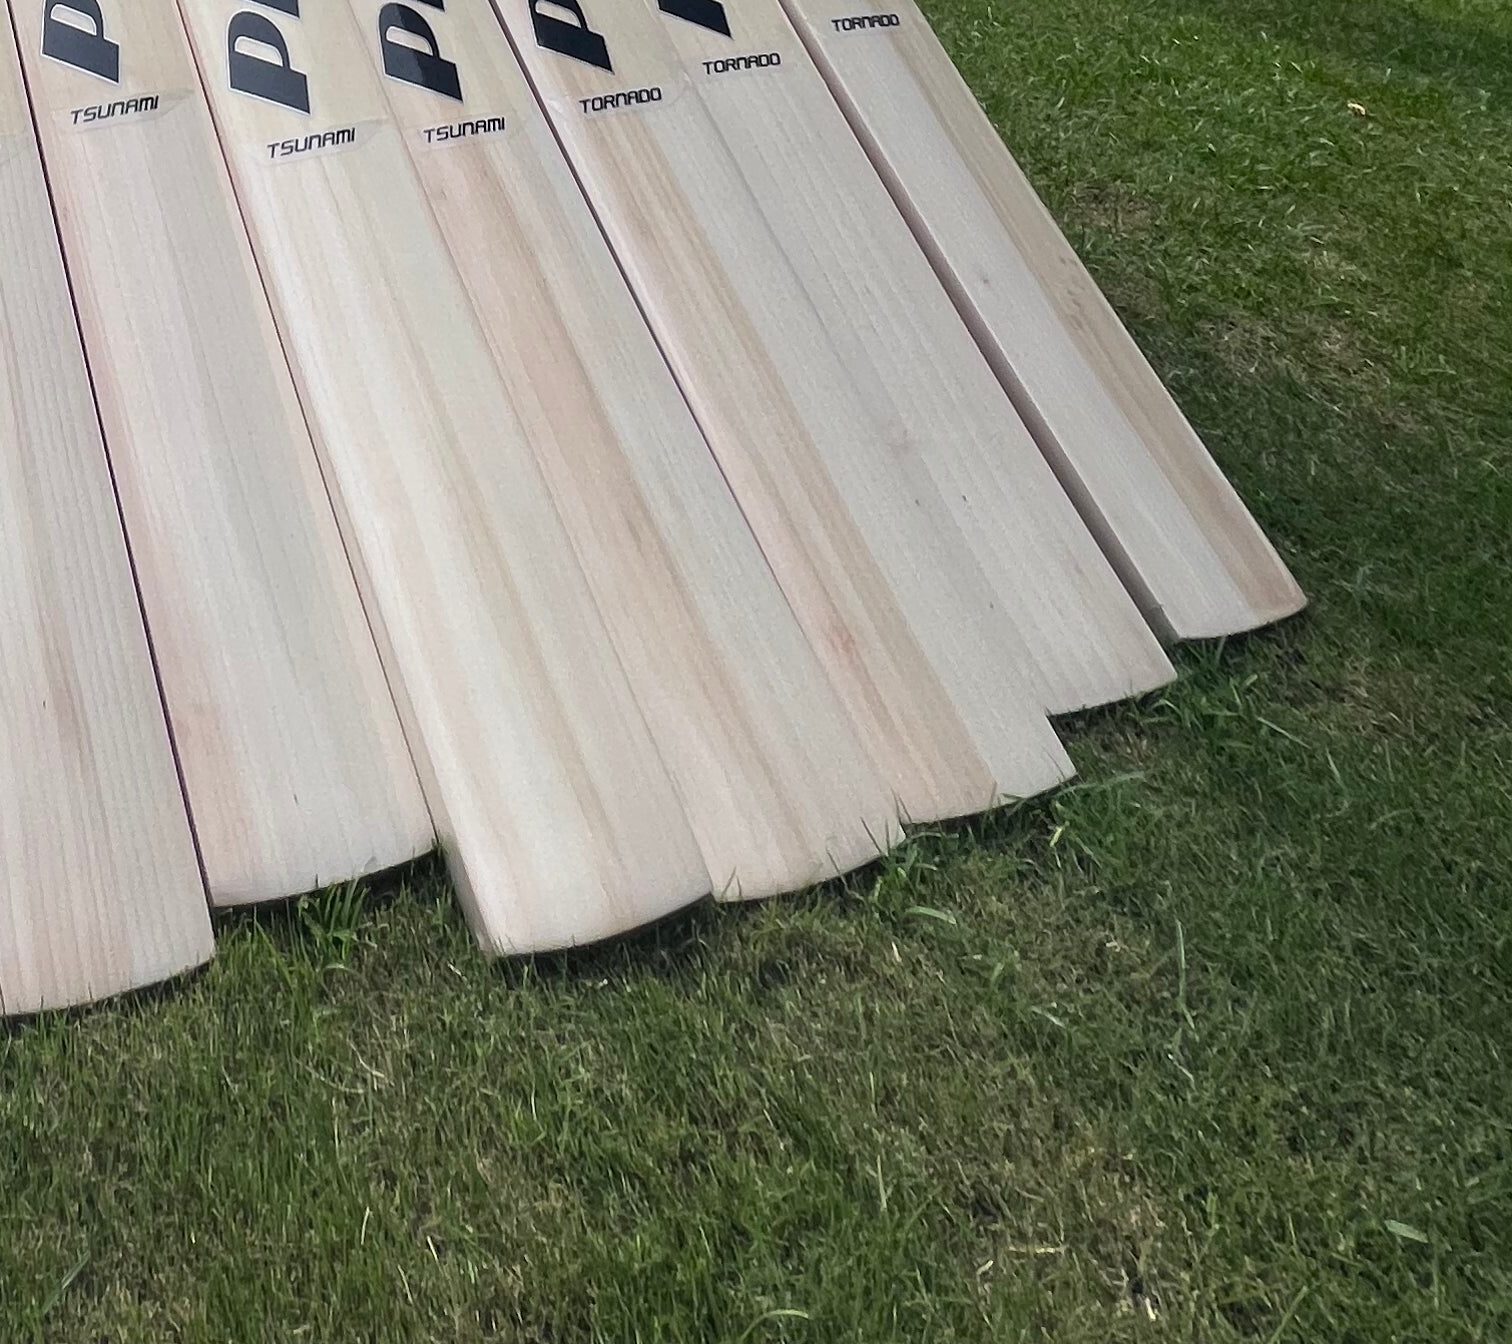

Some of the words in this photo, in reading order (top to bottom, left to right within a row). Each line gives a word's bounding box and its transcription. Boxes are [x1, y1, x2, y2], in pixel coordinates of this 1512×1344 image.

[830, 13, 900, 34] TORNADO
[702, 52, 781, 76] TORNADO
[70, 95, 160, 125] TSUNAMI
[579, 87, 663, 114] TORNADO
[267, 127, 356, 159] TSUNAMI
[423, 116, 506, 144] TSUNAMI
